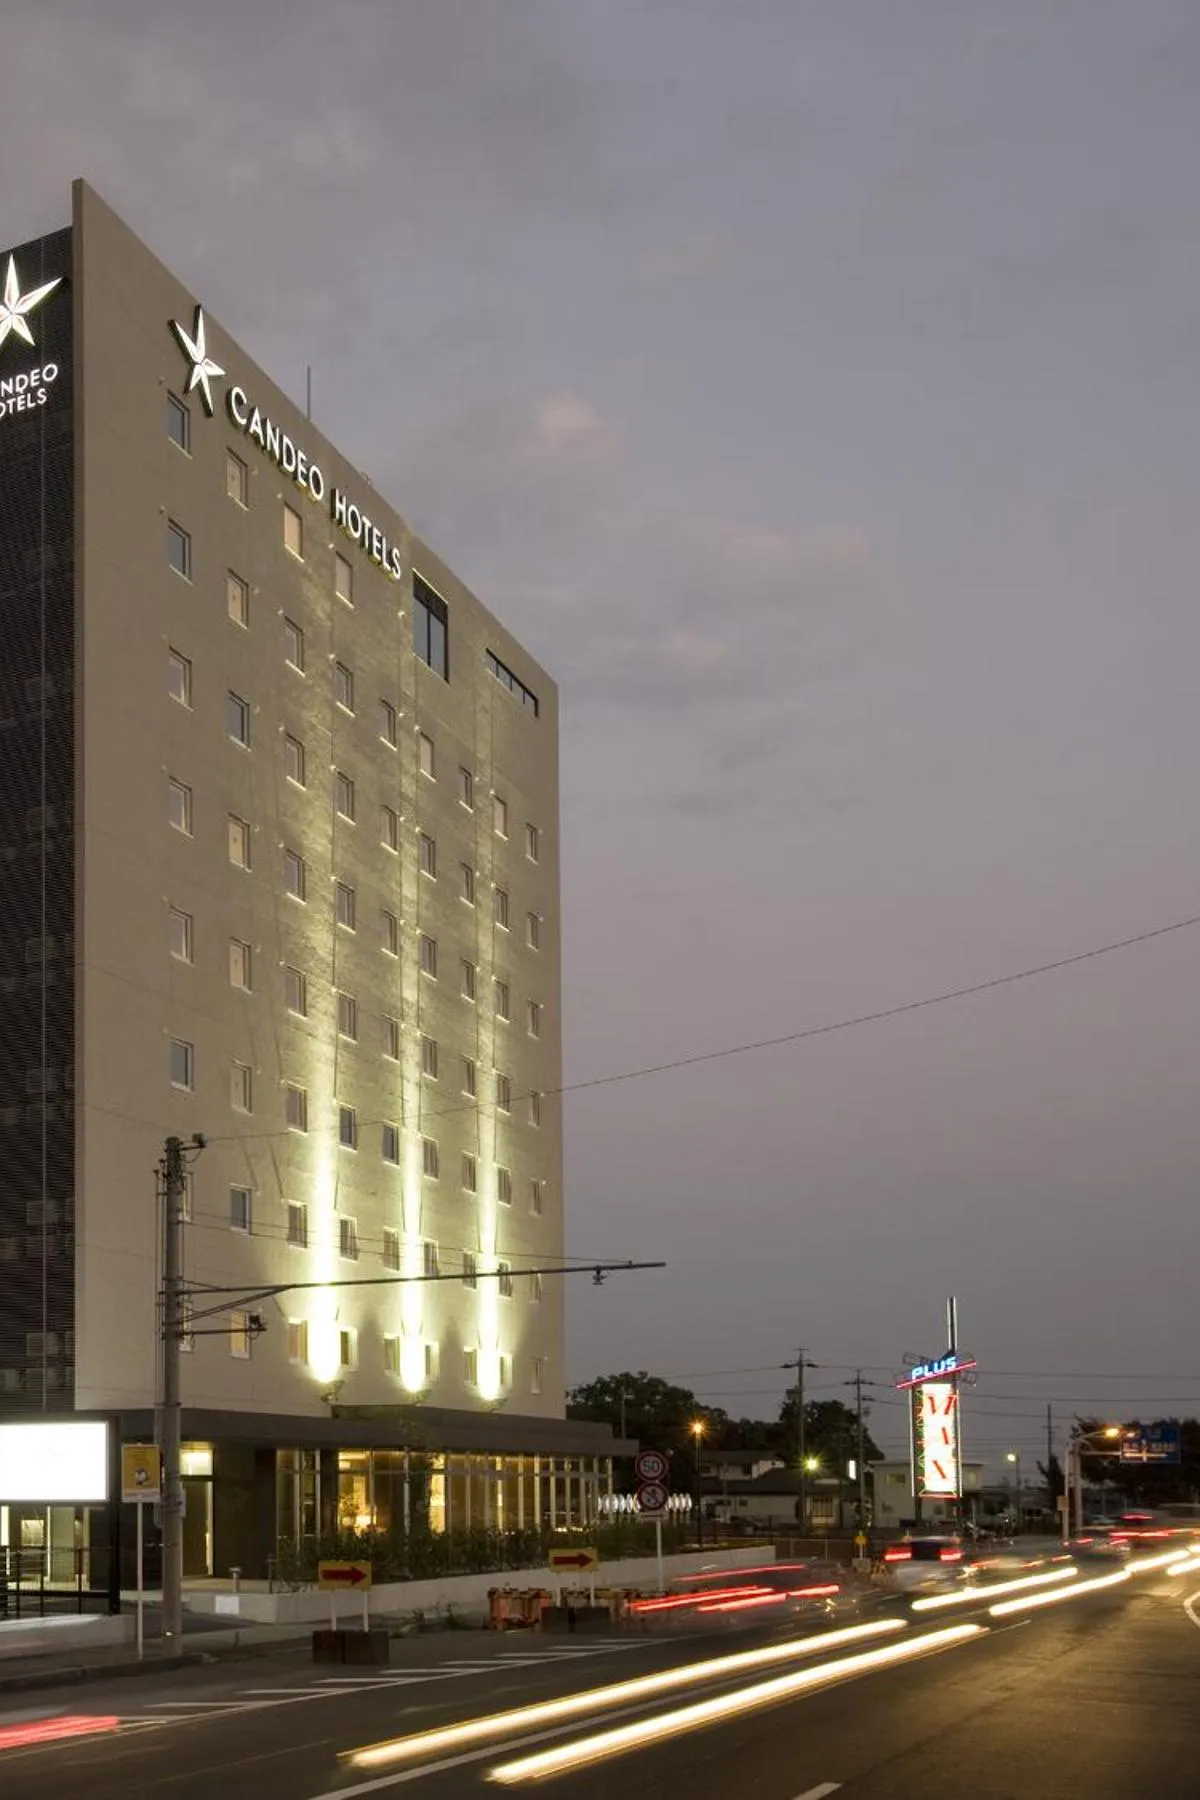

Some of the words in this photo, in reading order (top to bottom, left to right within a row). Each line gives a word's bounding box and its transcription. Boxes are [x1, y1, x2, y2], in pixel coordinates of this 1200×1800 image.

[230, 386, 324, 500] CANDEO
[333, 488, 401, 580] HOTELS
[911, 1356, 957, 1380] PLUS
